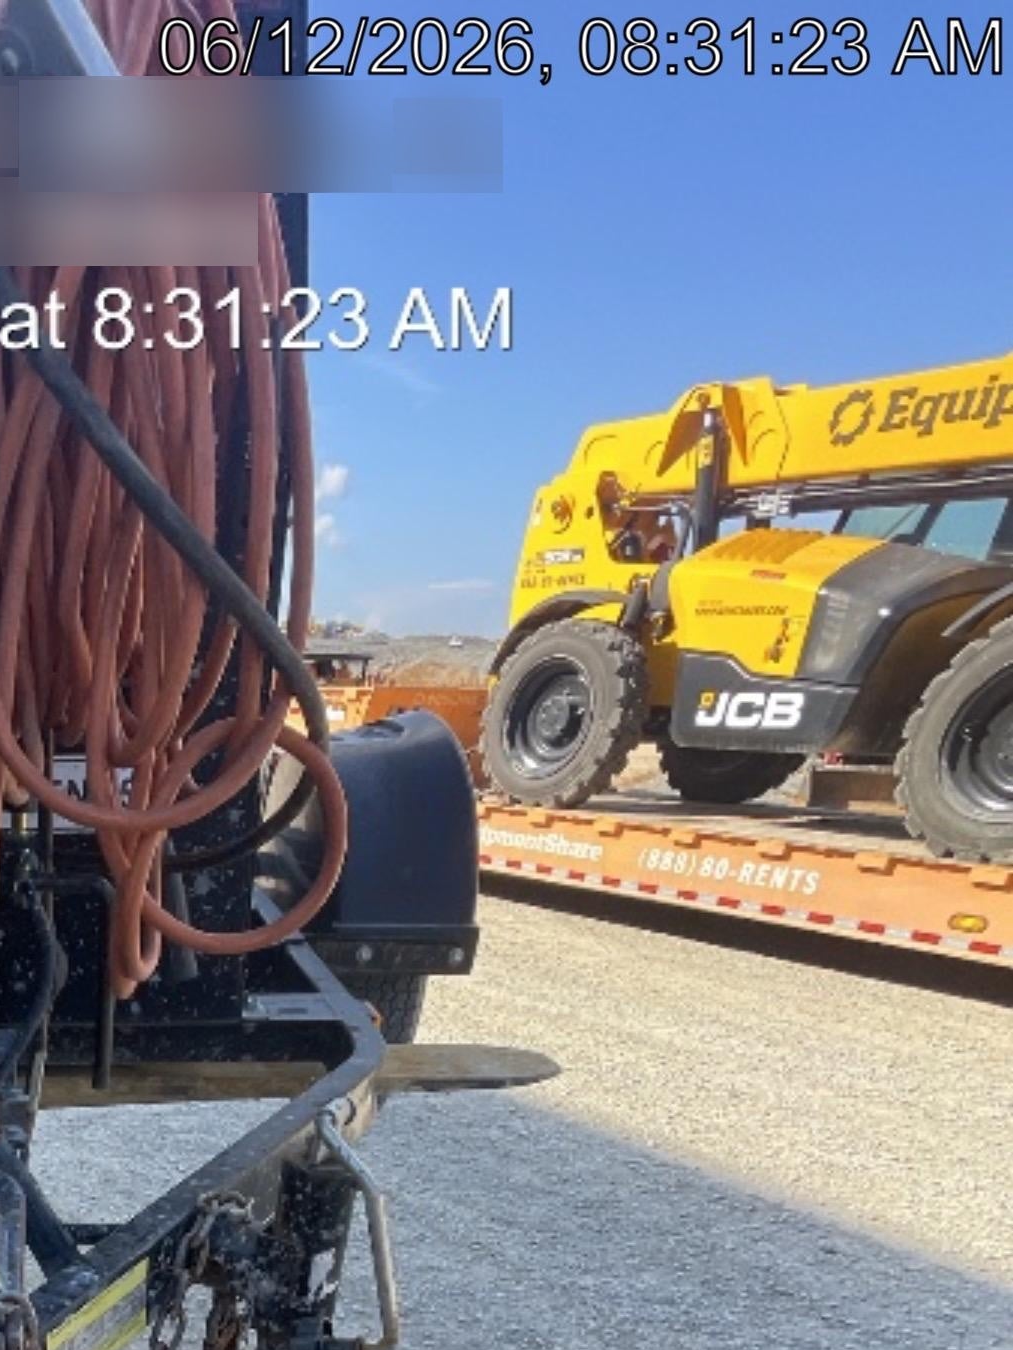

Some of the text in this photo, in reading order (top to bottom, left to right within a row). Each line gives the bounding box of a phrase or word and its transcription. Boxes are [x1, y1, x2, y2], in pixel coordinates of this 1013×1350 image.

[694, 691, 805, 729] JCB
[639, 848, 697, 877] (888)
[700, 855, 820, 896] 80-RENTS
